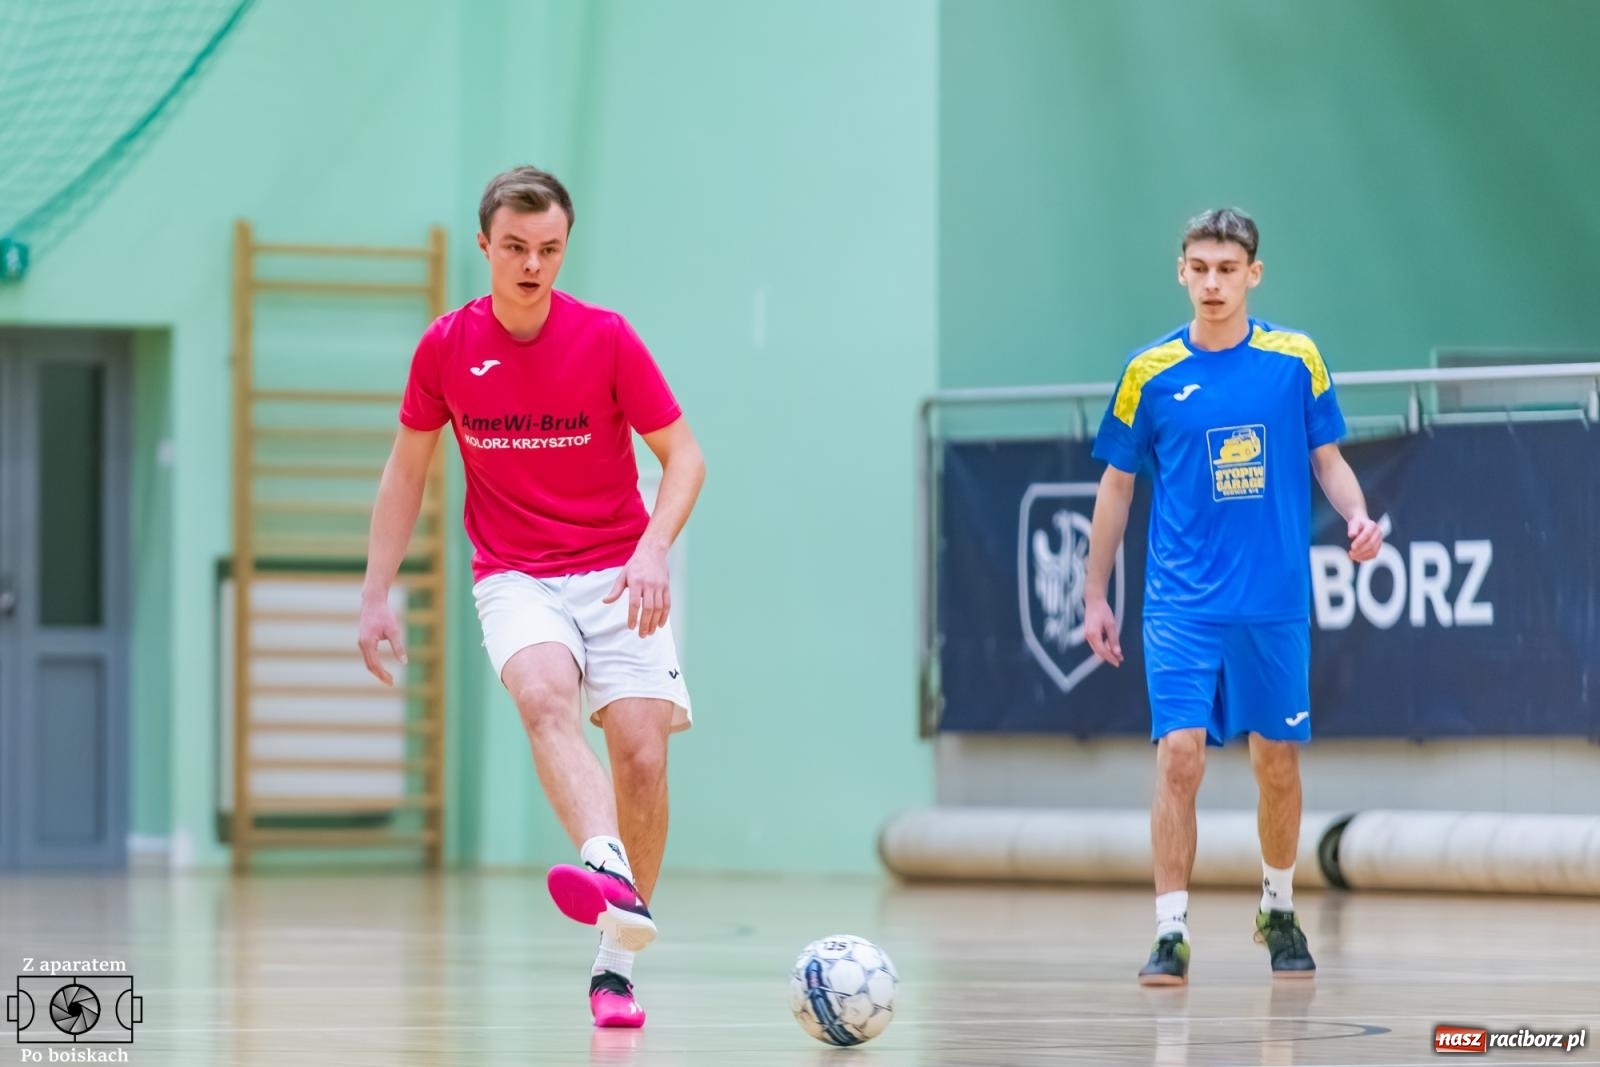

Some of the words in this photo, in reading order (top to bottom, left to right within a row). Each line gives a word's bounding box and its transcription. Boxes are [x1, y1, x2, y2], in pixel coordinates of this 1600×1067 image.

[461, 411, 590, 432] AmeWi-Bruk
[512, 433, 592, 449] KRZYSZTOF
[1309, 512, 1494, 631] BÓRZ
